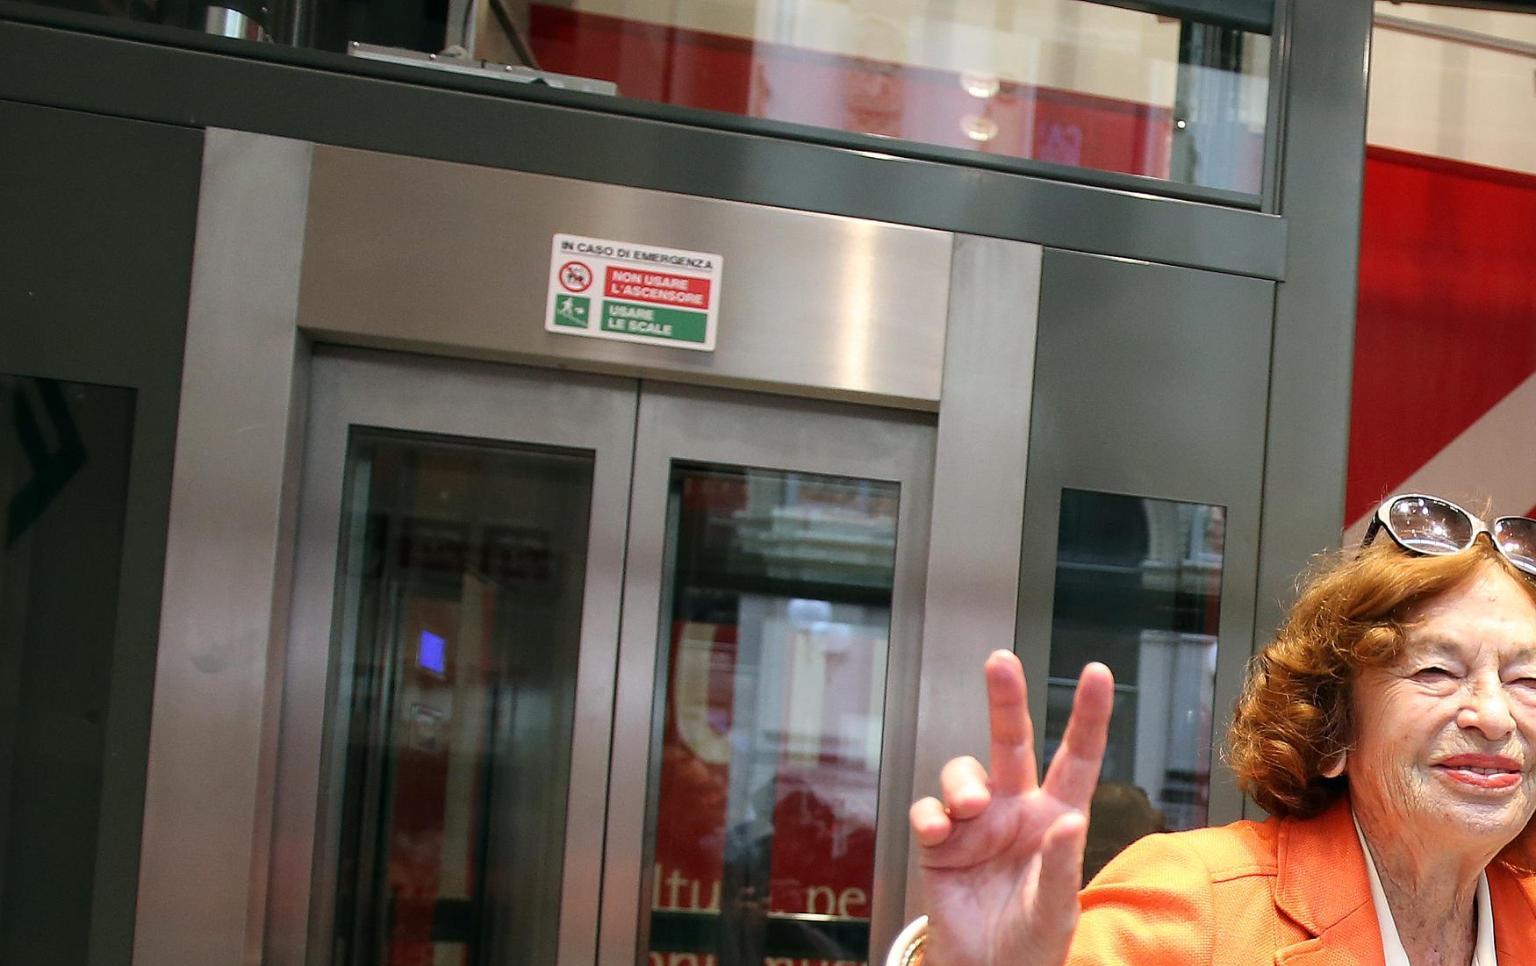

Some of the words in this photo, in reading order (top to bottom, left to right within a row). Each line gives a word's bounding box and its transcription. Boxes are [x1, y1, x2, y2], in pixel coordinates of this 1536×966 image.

[561, 241, 574, 250] IN
[577, 243, 614, 256] CASO
[617, 248, 630, 258] DI
[634, 251, 713, 269] EMERGENZA
[612, 270, 641, 285] NON
[644, 275, 689, 291] USARE
[611, 284, 704, 305] L'ASCENSORE
[609, 305, 654, 321] USARE
[608, 317, 626, 329] LE
[628, 320, 673, 336] SCALE
